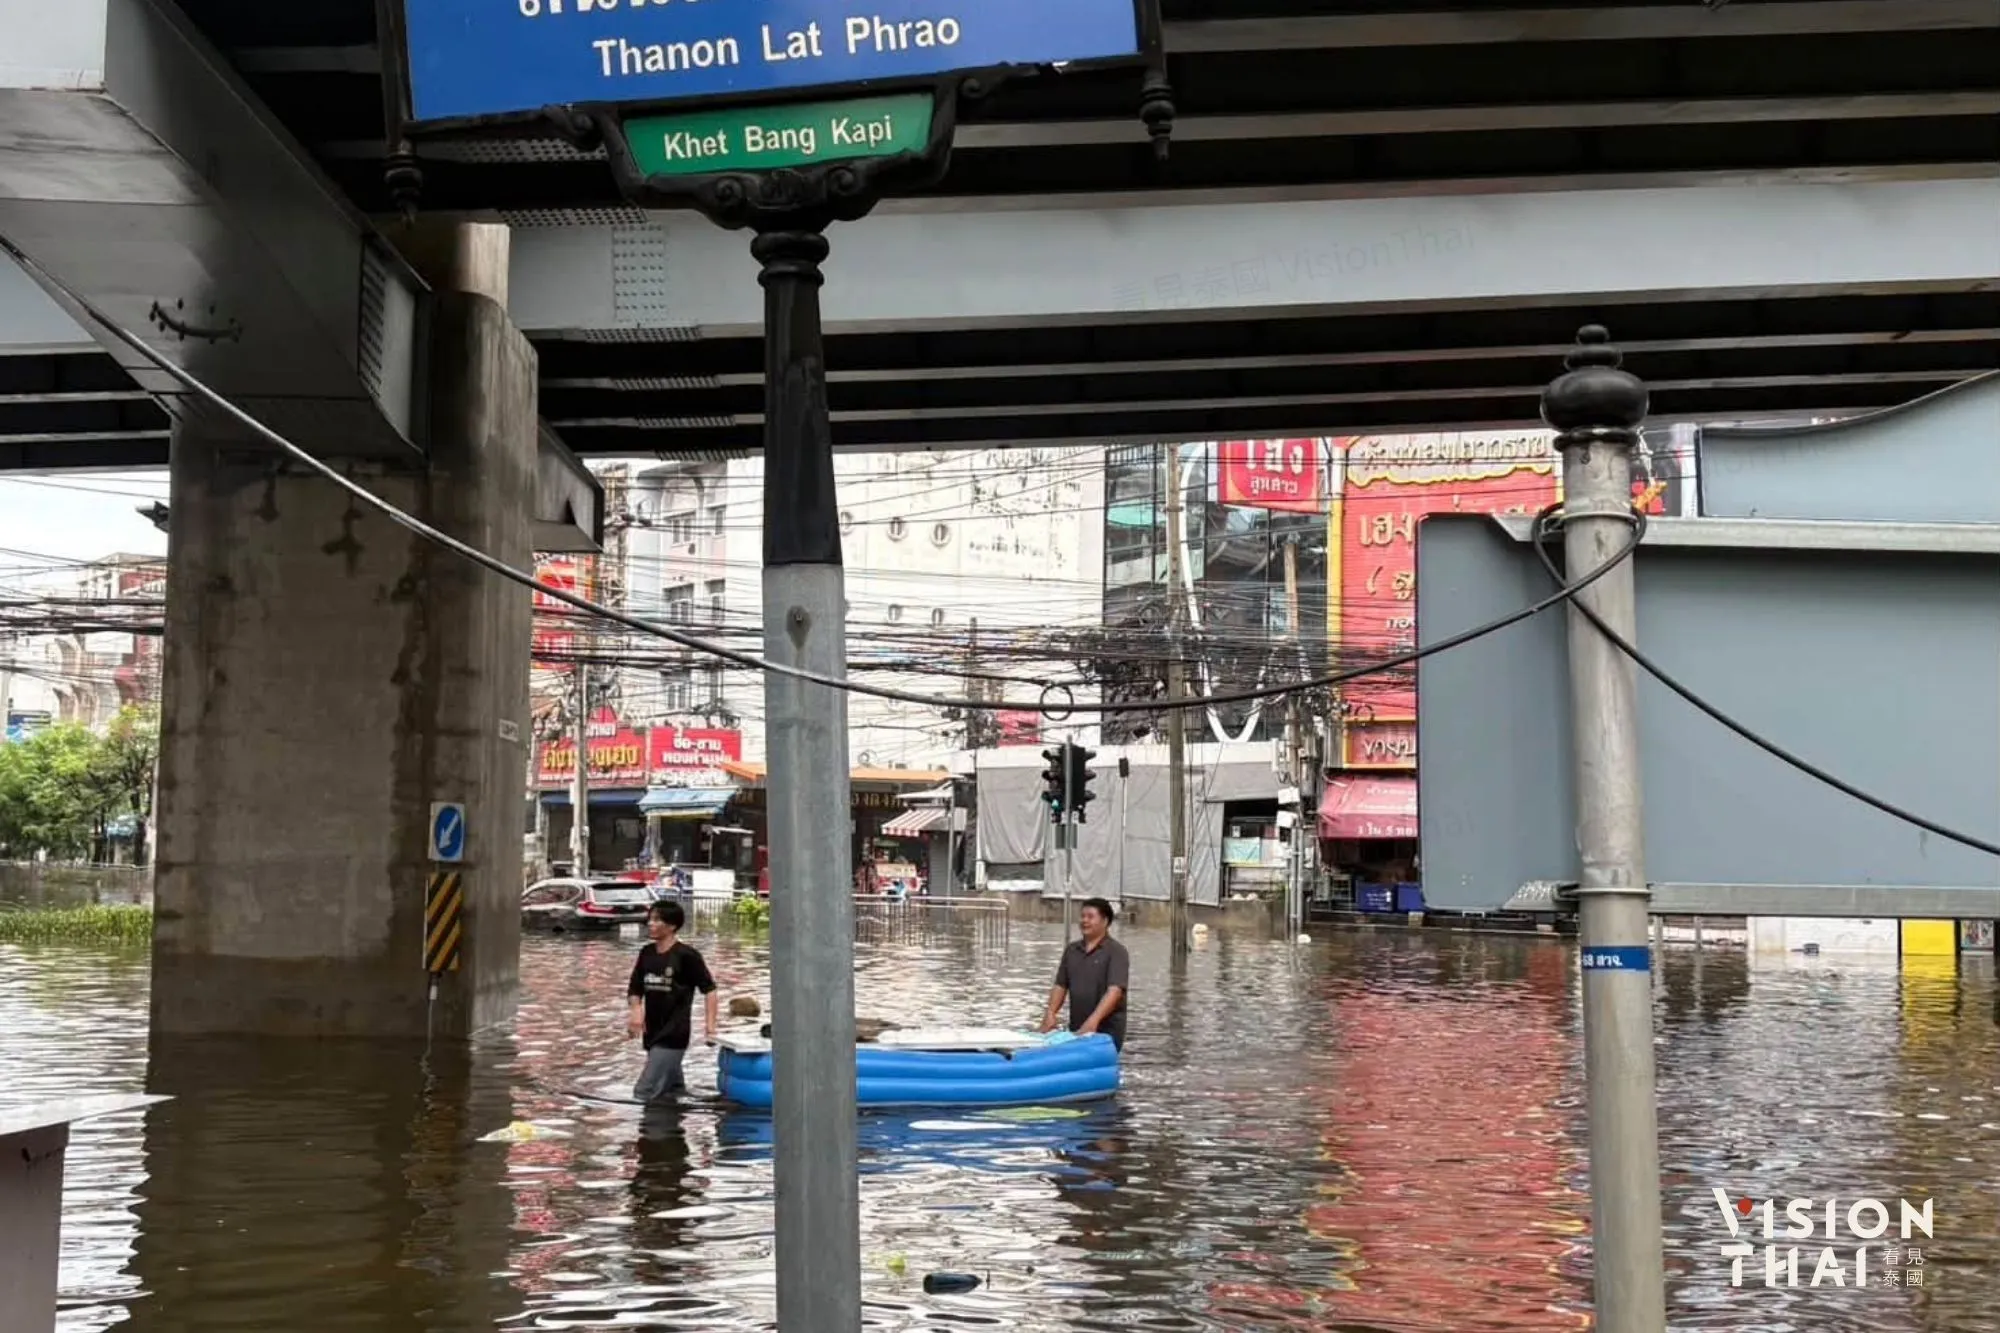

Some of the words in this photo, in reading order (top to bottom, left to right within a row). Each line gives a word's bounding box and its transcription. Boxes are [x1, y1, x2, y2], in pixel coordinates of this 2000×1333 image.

[593, 37, 740, 77] Thanon
[762, 21, 823, 61] Lat
[846, 15, 960, 54] Phrao
[664, 128, 729, 160] Khet
[744, 124, 815, 156] Bang
[832, 115, 893, 147] Kapi
